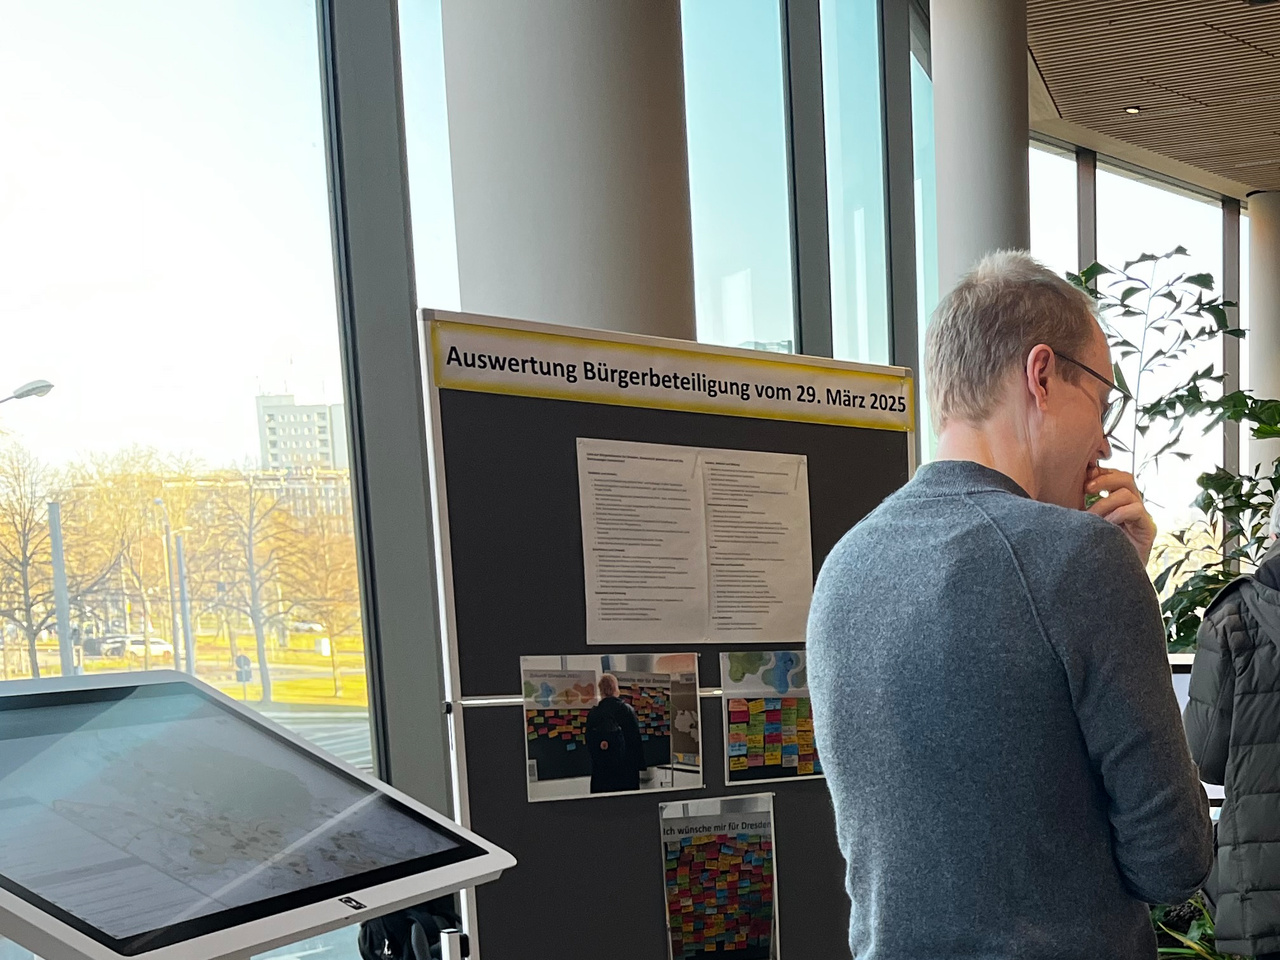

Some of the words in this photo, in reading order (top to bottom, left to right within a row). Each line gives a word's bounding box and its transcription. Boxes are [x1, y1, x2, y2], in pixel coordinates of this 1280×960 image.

[446, 345, 577, 383] Auswertung
[583, 361, 750, 401] Bürgerbeteiligung
[755, 383, 791, 401] vom
[796, 385, 821, 404] 29.
[826, 388, 866, 409] März
[869, 392, 906, 413] 2025
[663, 827, 675, 836] Ich
[677, 825, 712, 835] wünsche
[714, 824, 726, 832] mir
[728, 822, 739, 831] für
[741, 821, 771, 830] Dresden
